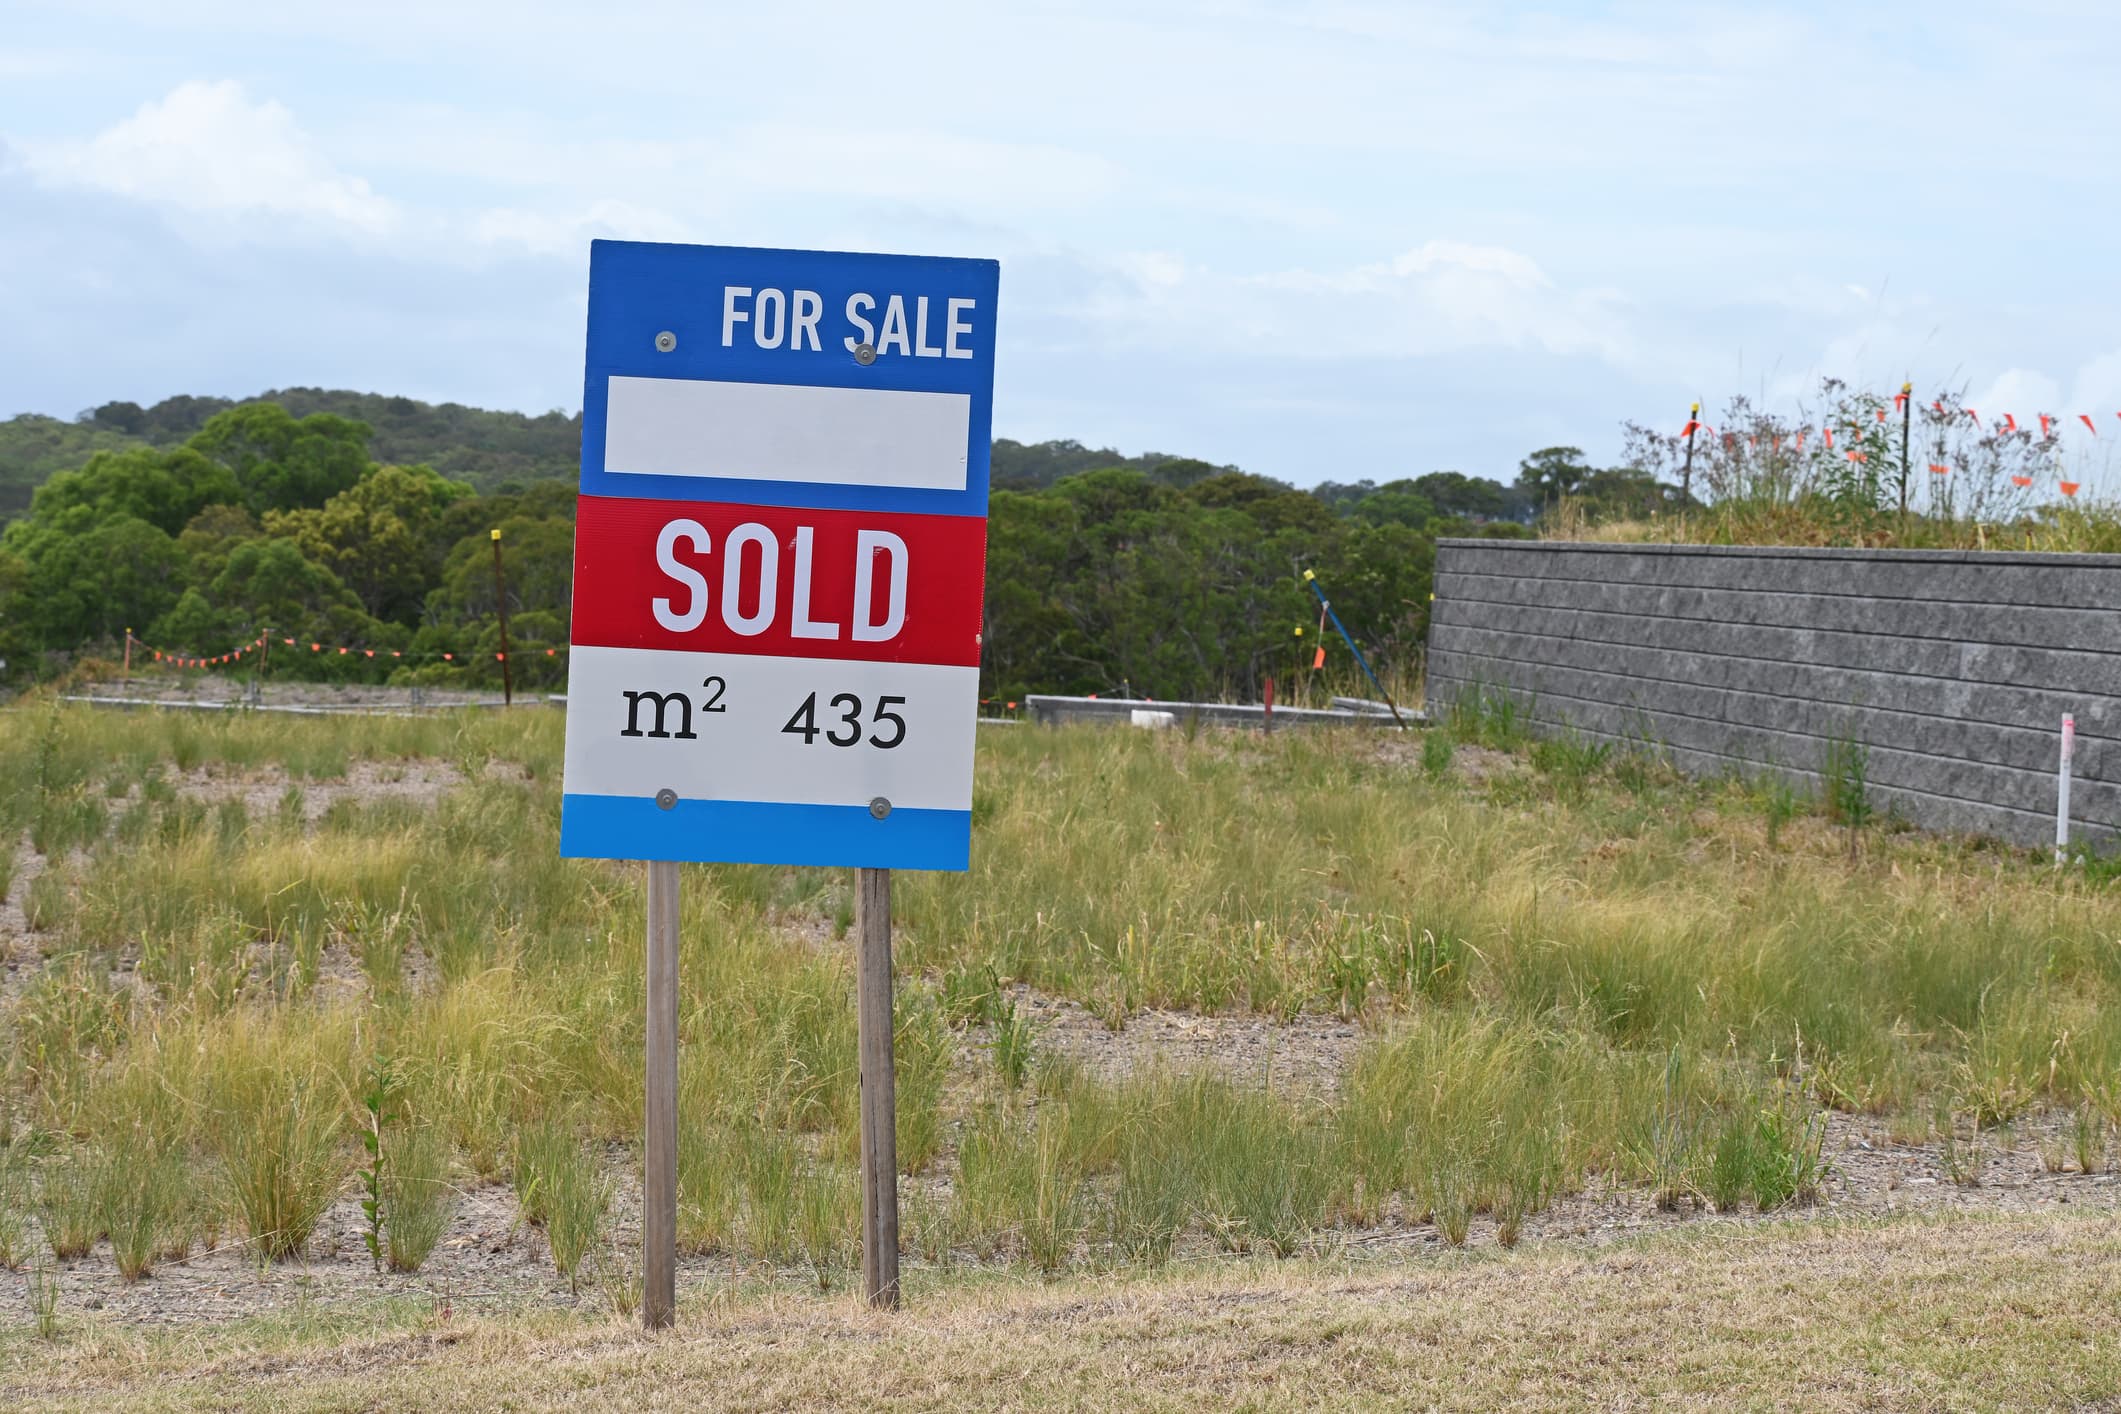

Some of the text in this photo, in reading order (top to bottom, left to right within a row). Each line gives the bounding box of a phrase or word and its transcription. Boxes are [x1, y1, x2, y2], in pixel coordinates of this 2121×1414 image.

[721, 285, 976, 360] FOR SALE
[652, 518, 909, 642] SOLD
[780, 691, 907, 748] 435
